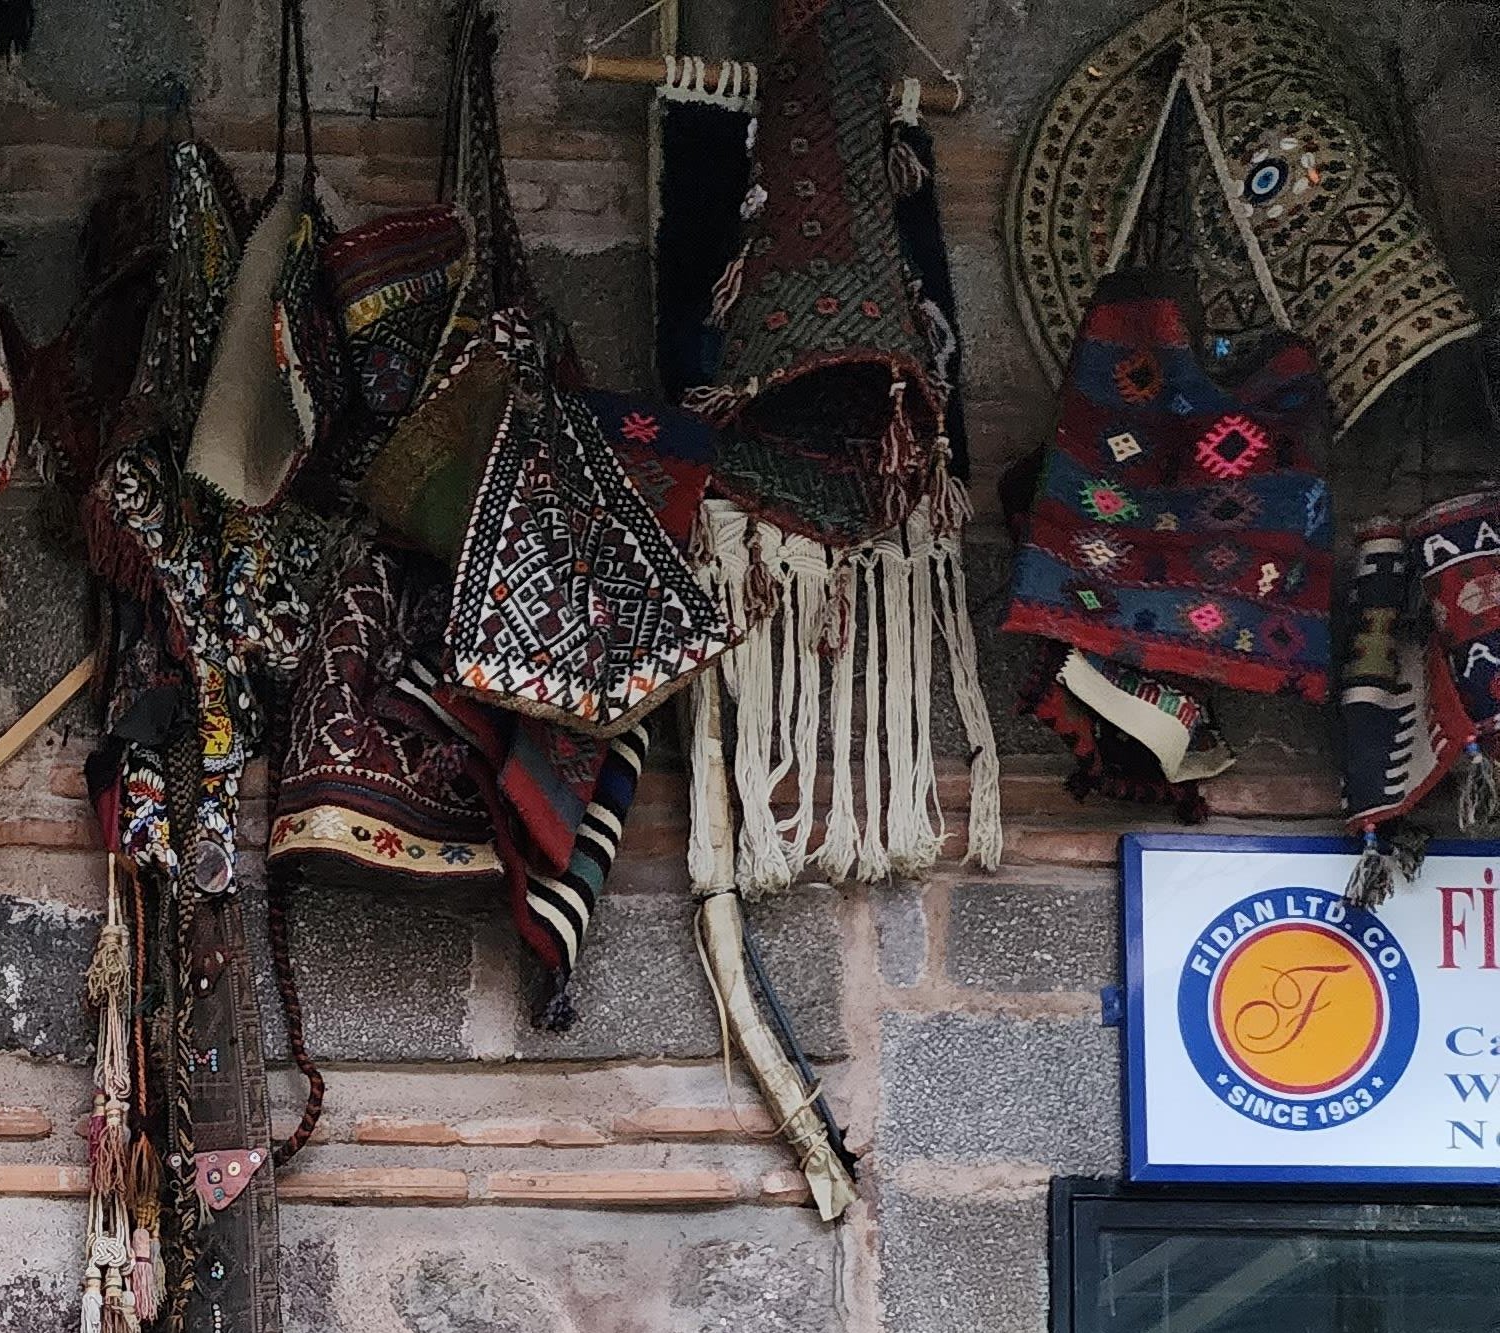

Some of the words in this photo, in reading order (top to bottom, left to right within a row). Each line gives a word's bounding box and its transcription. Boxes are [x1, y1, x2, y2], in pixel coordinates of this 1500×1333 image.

[1286, 895, 1352, 930] LTD.
[1362, 926, 1401, 981] CO.
[1227, 1085, 1308, 1126] SINCE
[1315, 1087, 1374, 1125] 1963
